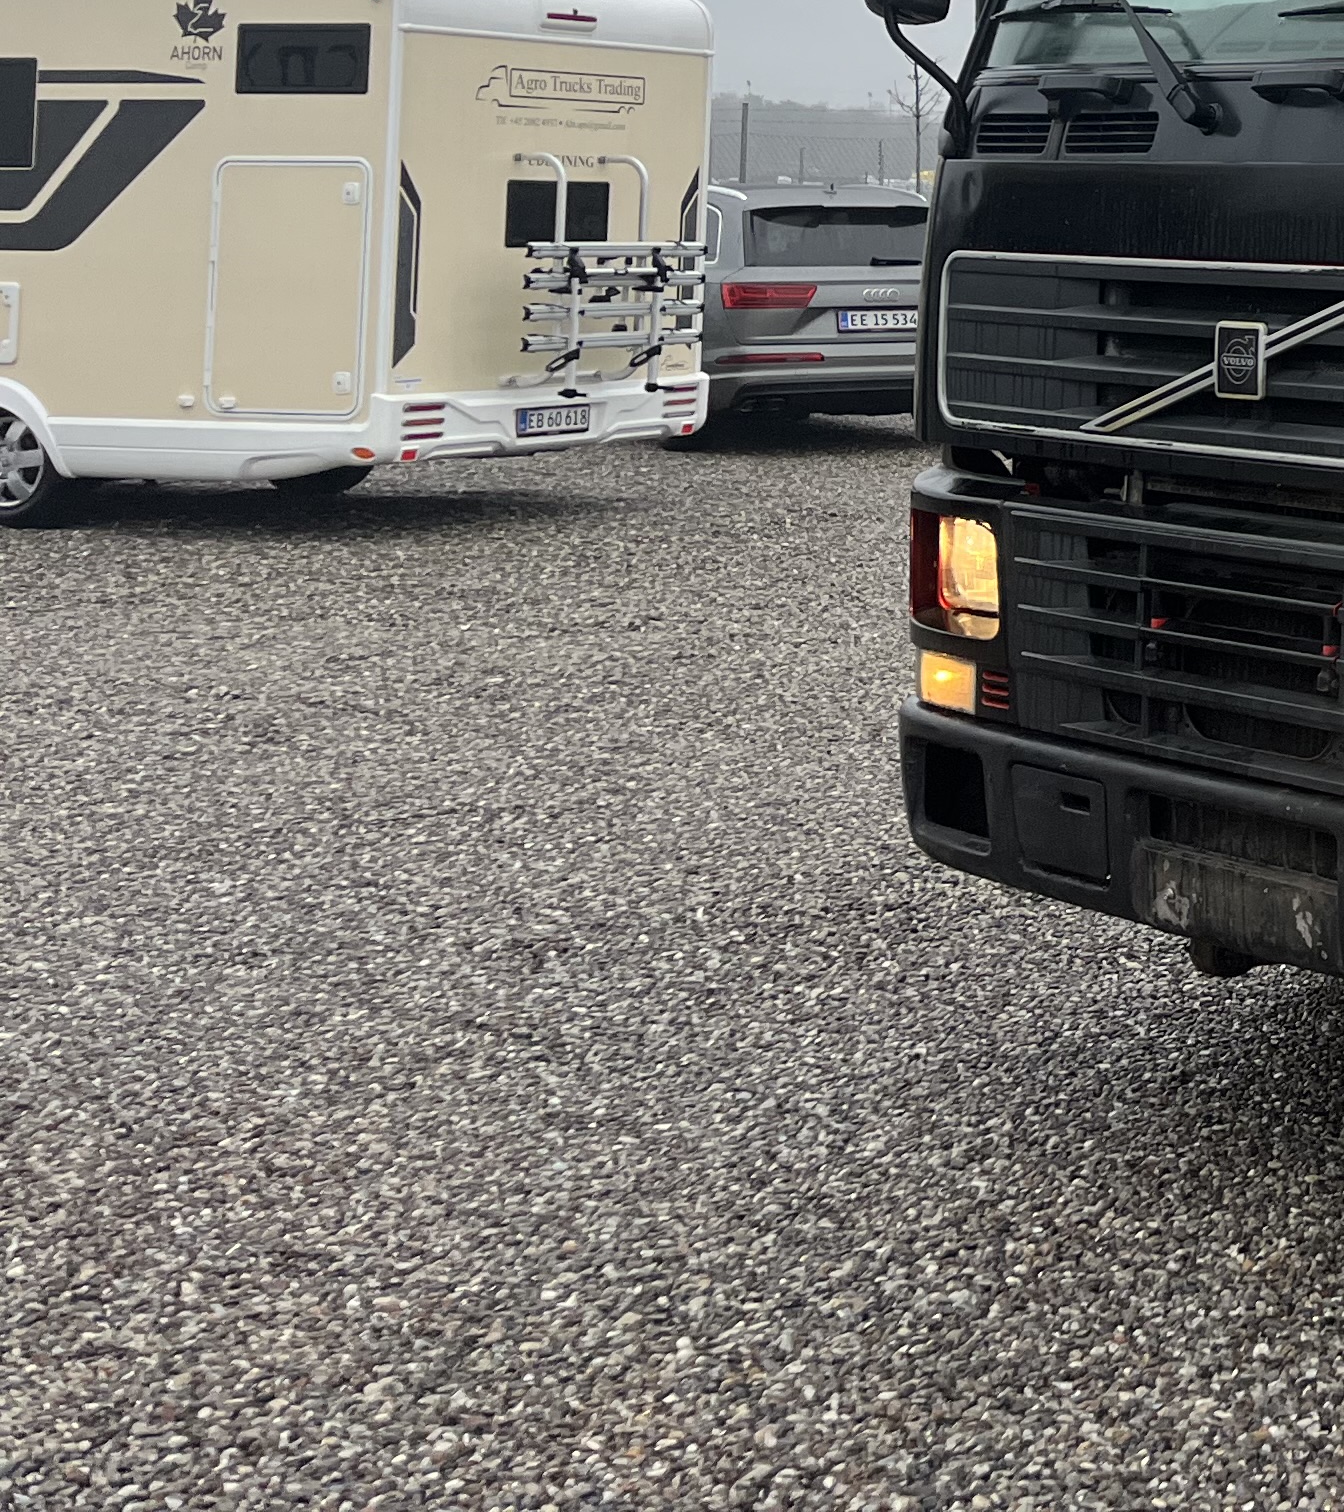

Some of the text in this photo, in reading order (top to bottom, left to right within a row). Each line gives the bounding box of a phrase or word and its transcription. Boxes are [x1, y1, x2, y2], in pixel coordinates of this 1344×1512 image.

[170, 45, 223, 61] AHORN
[514, 73, 641, 101] Agro Trucks Trading
[850, 312, 917, 326] EE 15 534
[1222, 356, 1254, 366] VOLVO
[528, 409, 587, 429] EB 60 618
